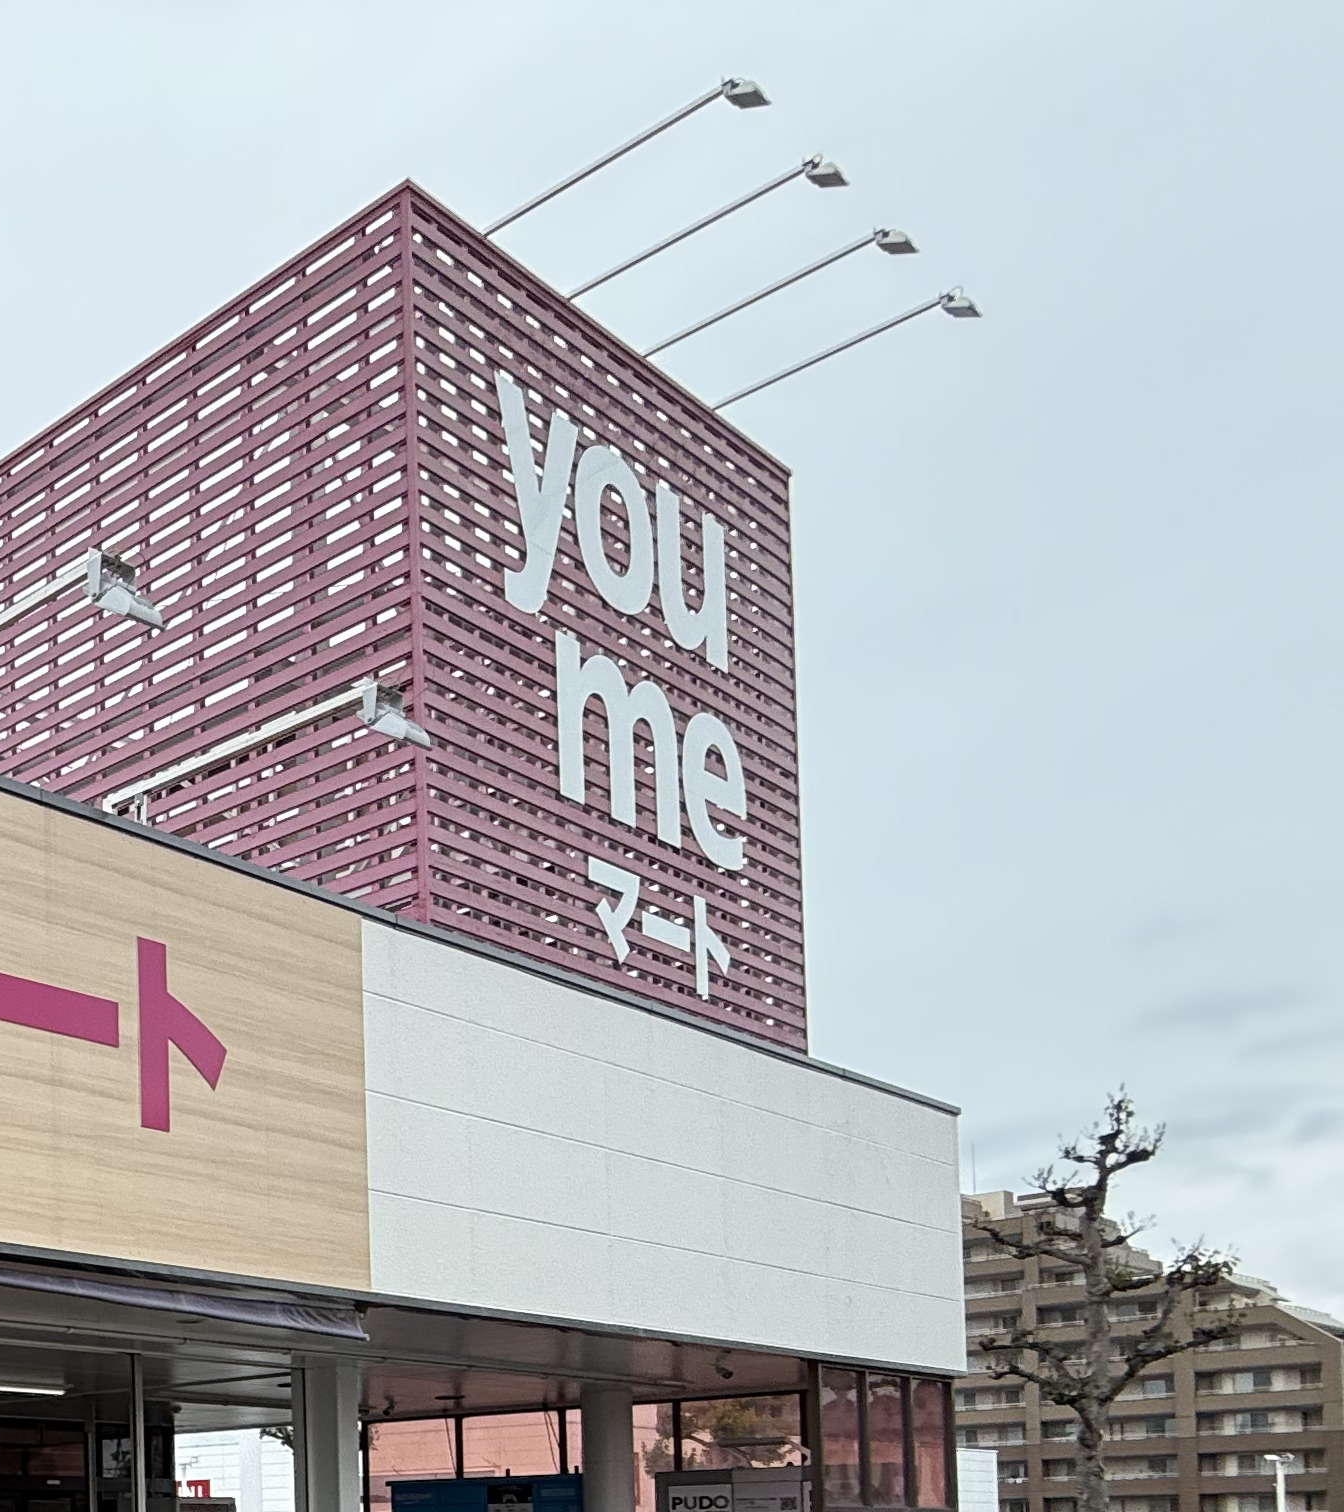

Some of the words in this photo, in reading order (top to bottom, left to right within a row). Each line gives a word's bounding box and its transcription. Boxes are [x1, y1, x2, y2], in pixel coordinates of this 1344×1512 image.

[494, 368, 729, 674] you
[554, 627, 749, 872] me
[586, 855, 732, 1001] マート
[671, 1495, 730, 1511] PUDO
